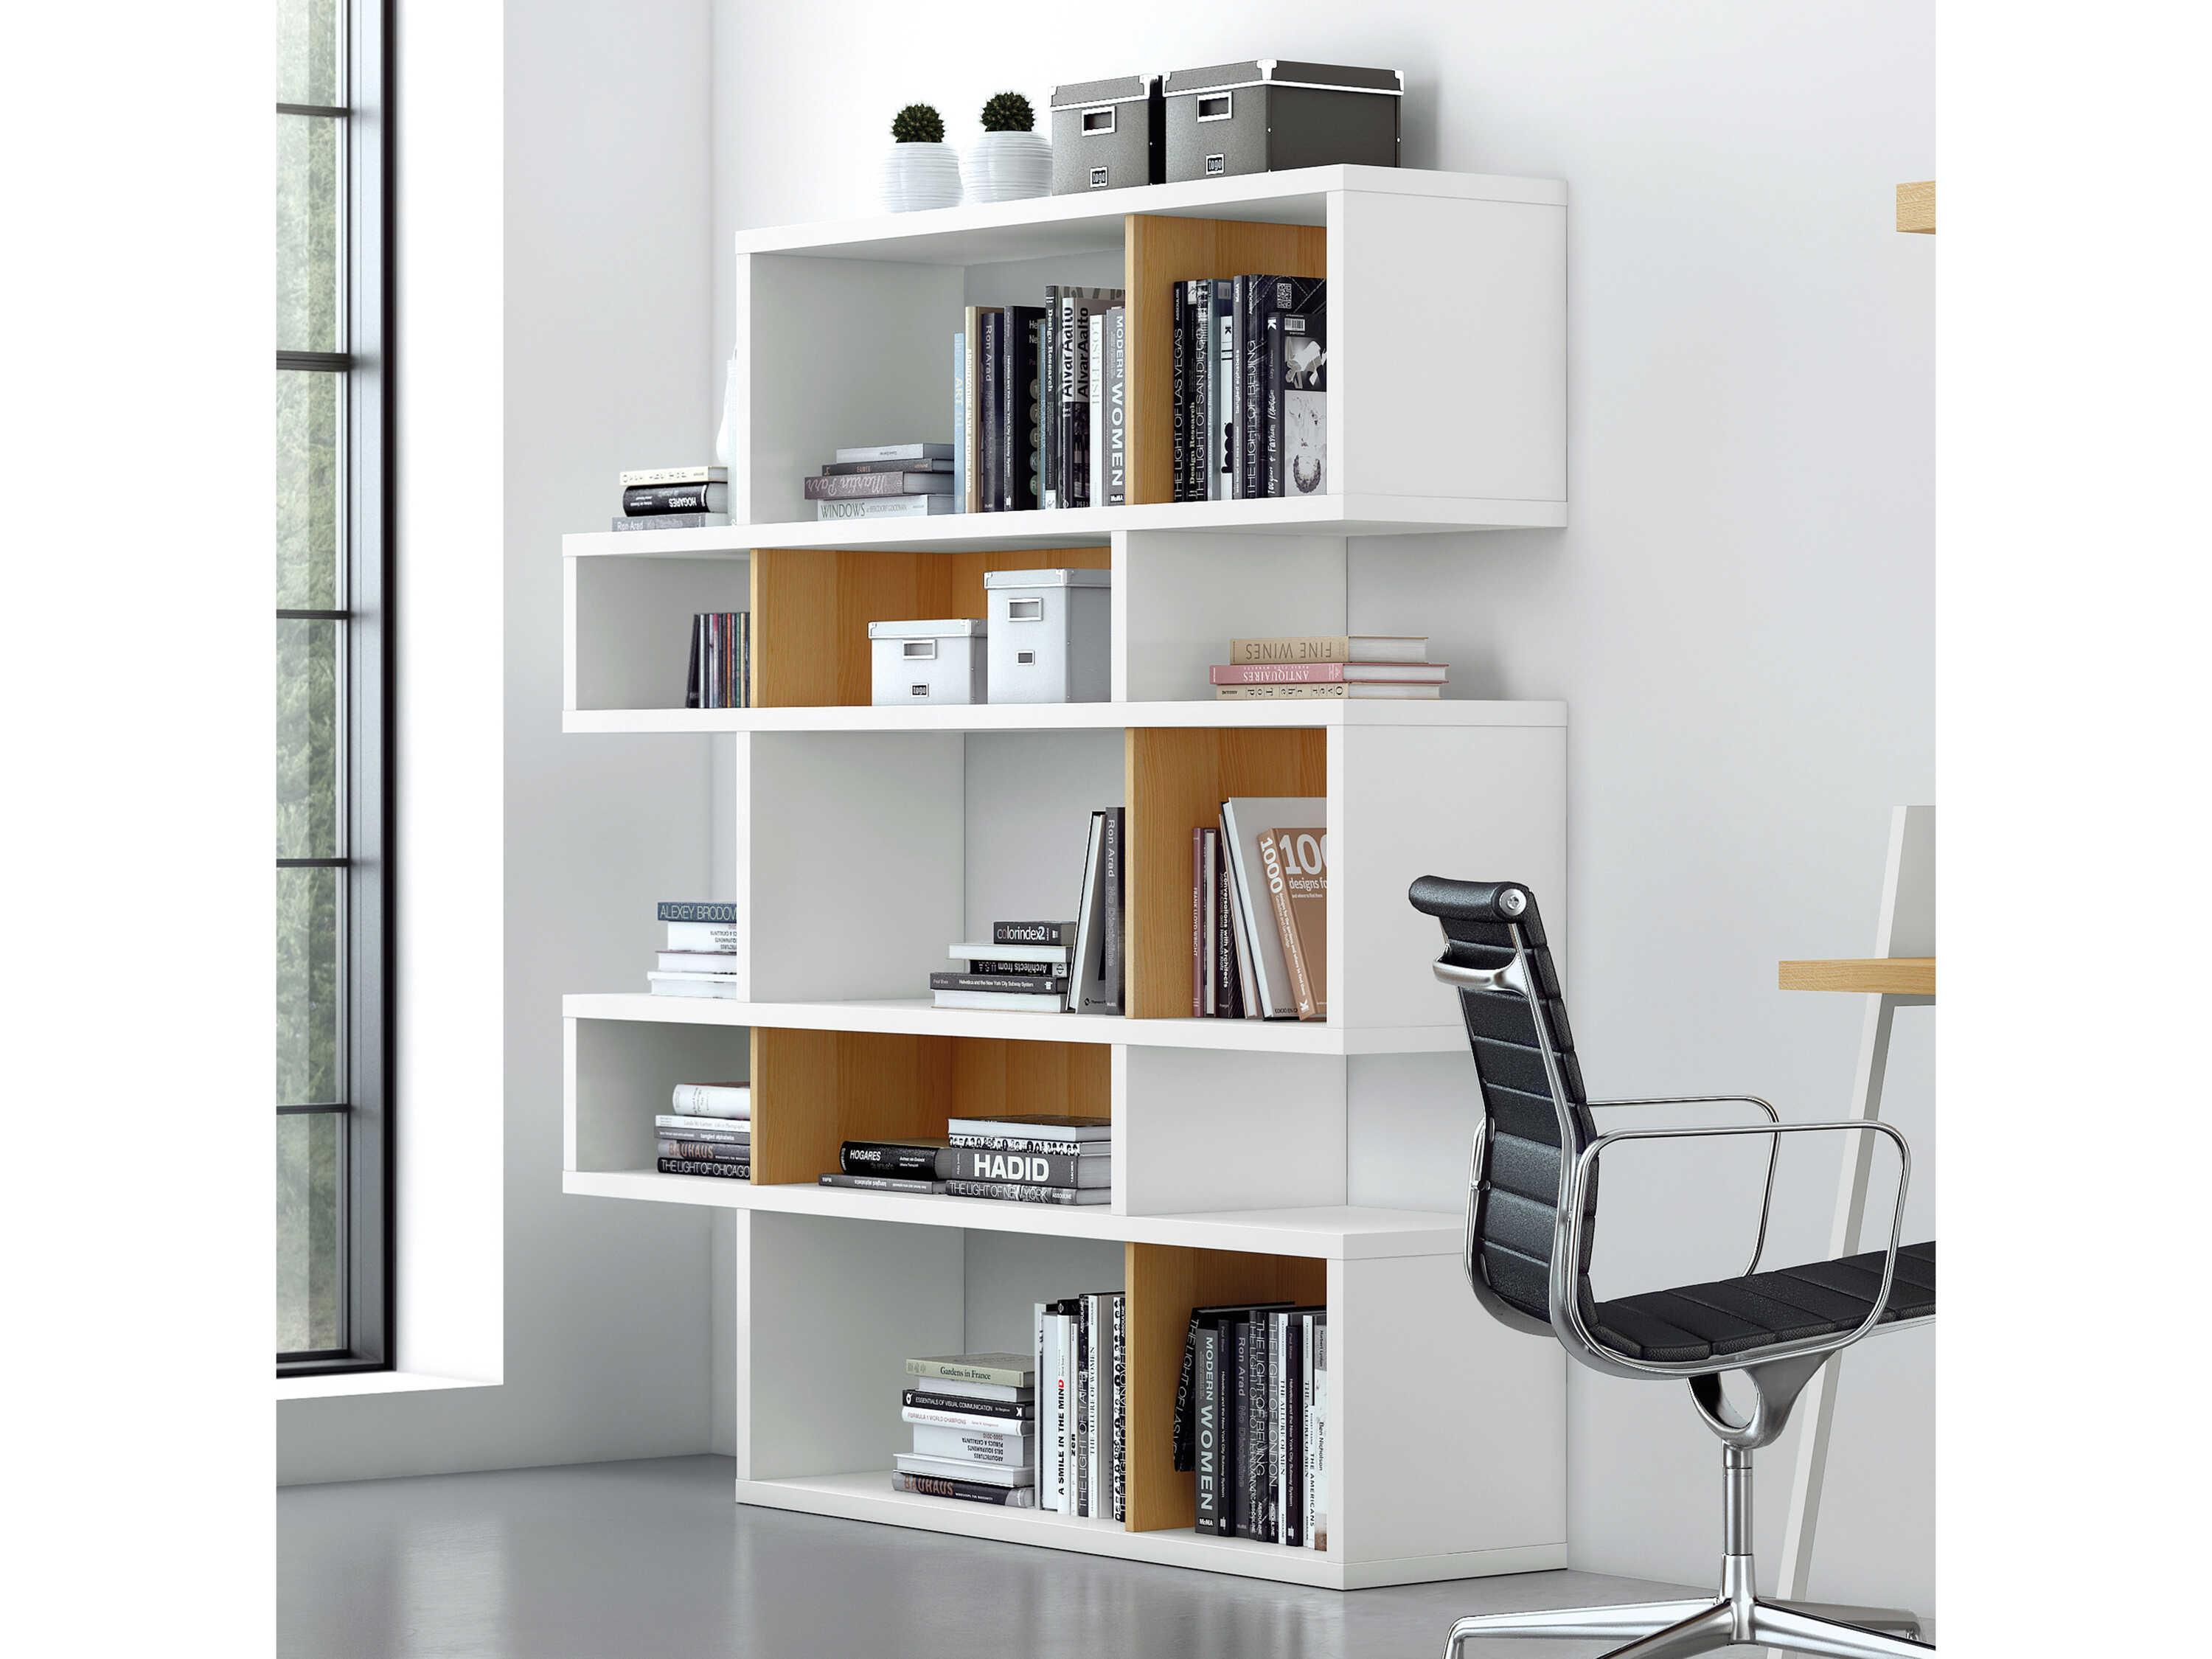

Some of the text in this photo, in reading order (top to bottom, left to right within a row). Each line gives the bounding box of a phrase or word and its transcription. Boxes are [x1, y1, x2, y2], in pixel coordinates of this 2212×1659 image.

[1196, 376, 1205, 404] SAN
[1175, 329, 1183, 500] THE LIGHT OF LAS VEGAS
[1196, 406, 1205, 425] OF
[1247, 341, 1256, 495] THE LIGHT OF BEIJING
[1112, 382, 1123, 486] WOMEN
[1196, 429, 1205, 468] LIGHT
[1196, 473, 1205, 499] THE
[669, 497, 696, 507] HOGARES
[821, 503, 865, 518] WINDOWS
[1246, 641, 1331, 660] FINE WINES
[1243, 669, 1310, 682] ANTIQUAIRES
[1261, 838, 1283, 894] 1000
[1289, 877, 1319, 891] designs
[660, 905, 694, 919] ALEXEY
[997, 926, 1045, 940] colorindex2
[998, 962, 1047, 973] Architects from
[669, 1142, 714, 1158] BAUHAUS
[850, 1150, 881, 1161] HOGARES
[661, 1159, 750, 1177] THE LIGHT OF CHICAGO
[974, 1154, 1049, 1182] HADID
[950, 1182, 966, 1194] THE
[967, 1183, 990, 1195] LIGHT
[991, 1186, 1002, 1197] OF
[1024, 1186, 1048, 1201] YORK
[1187, 1319, 1199, 1345] THE
[940, 1367, 963, 1377] Gardens
[972, 1371, 991, 1380] France
[1180, 1346, 1194, 1385] LIGHT
[1089, 1384, 1095, 1397] OF
[1178, 1387, 1187, 1406] OF
[1256, 1320, 1265, 1476] THE LIGHT OF BEIJING
[915, 1397, 939, 1405] ESSENTIALS
[959, 1402, 992, 1411] COMMUNICATION
[1269, 1321, 1277, 1487] THE LIGHT OF LONDON
[908, 1412, 926, 1420] FORMULA
[944, 1416, 966, 1424] CHAMPIONS
[1079, 1414, 1087, 1434] OF
[1238, 1406, 1246, 1423] No
[1058, 1436, 1064, 1447] IN
[1280, 1437, 1286, 1450] OF
[1304, 1439, 1309, 1453] OF
[1201, 1405, 1212, 1510] WOMEN
[905, 1475, 954, 1495] BAUHAUS
